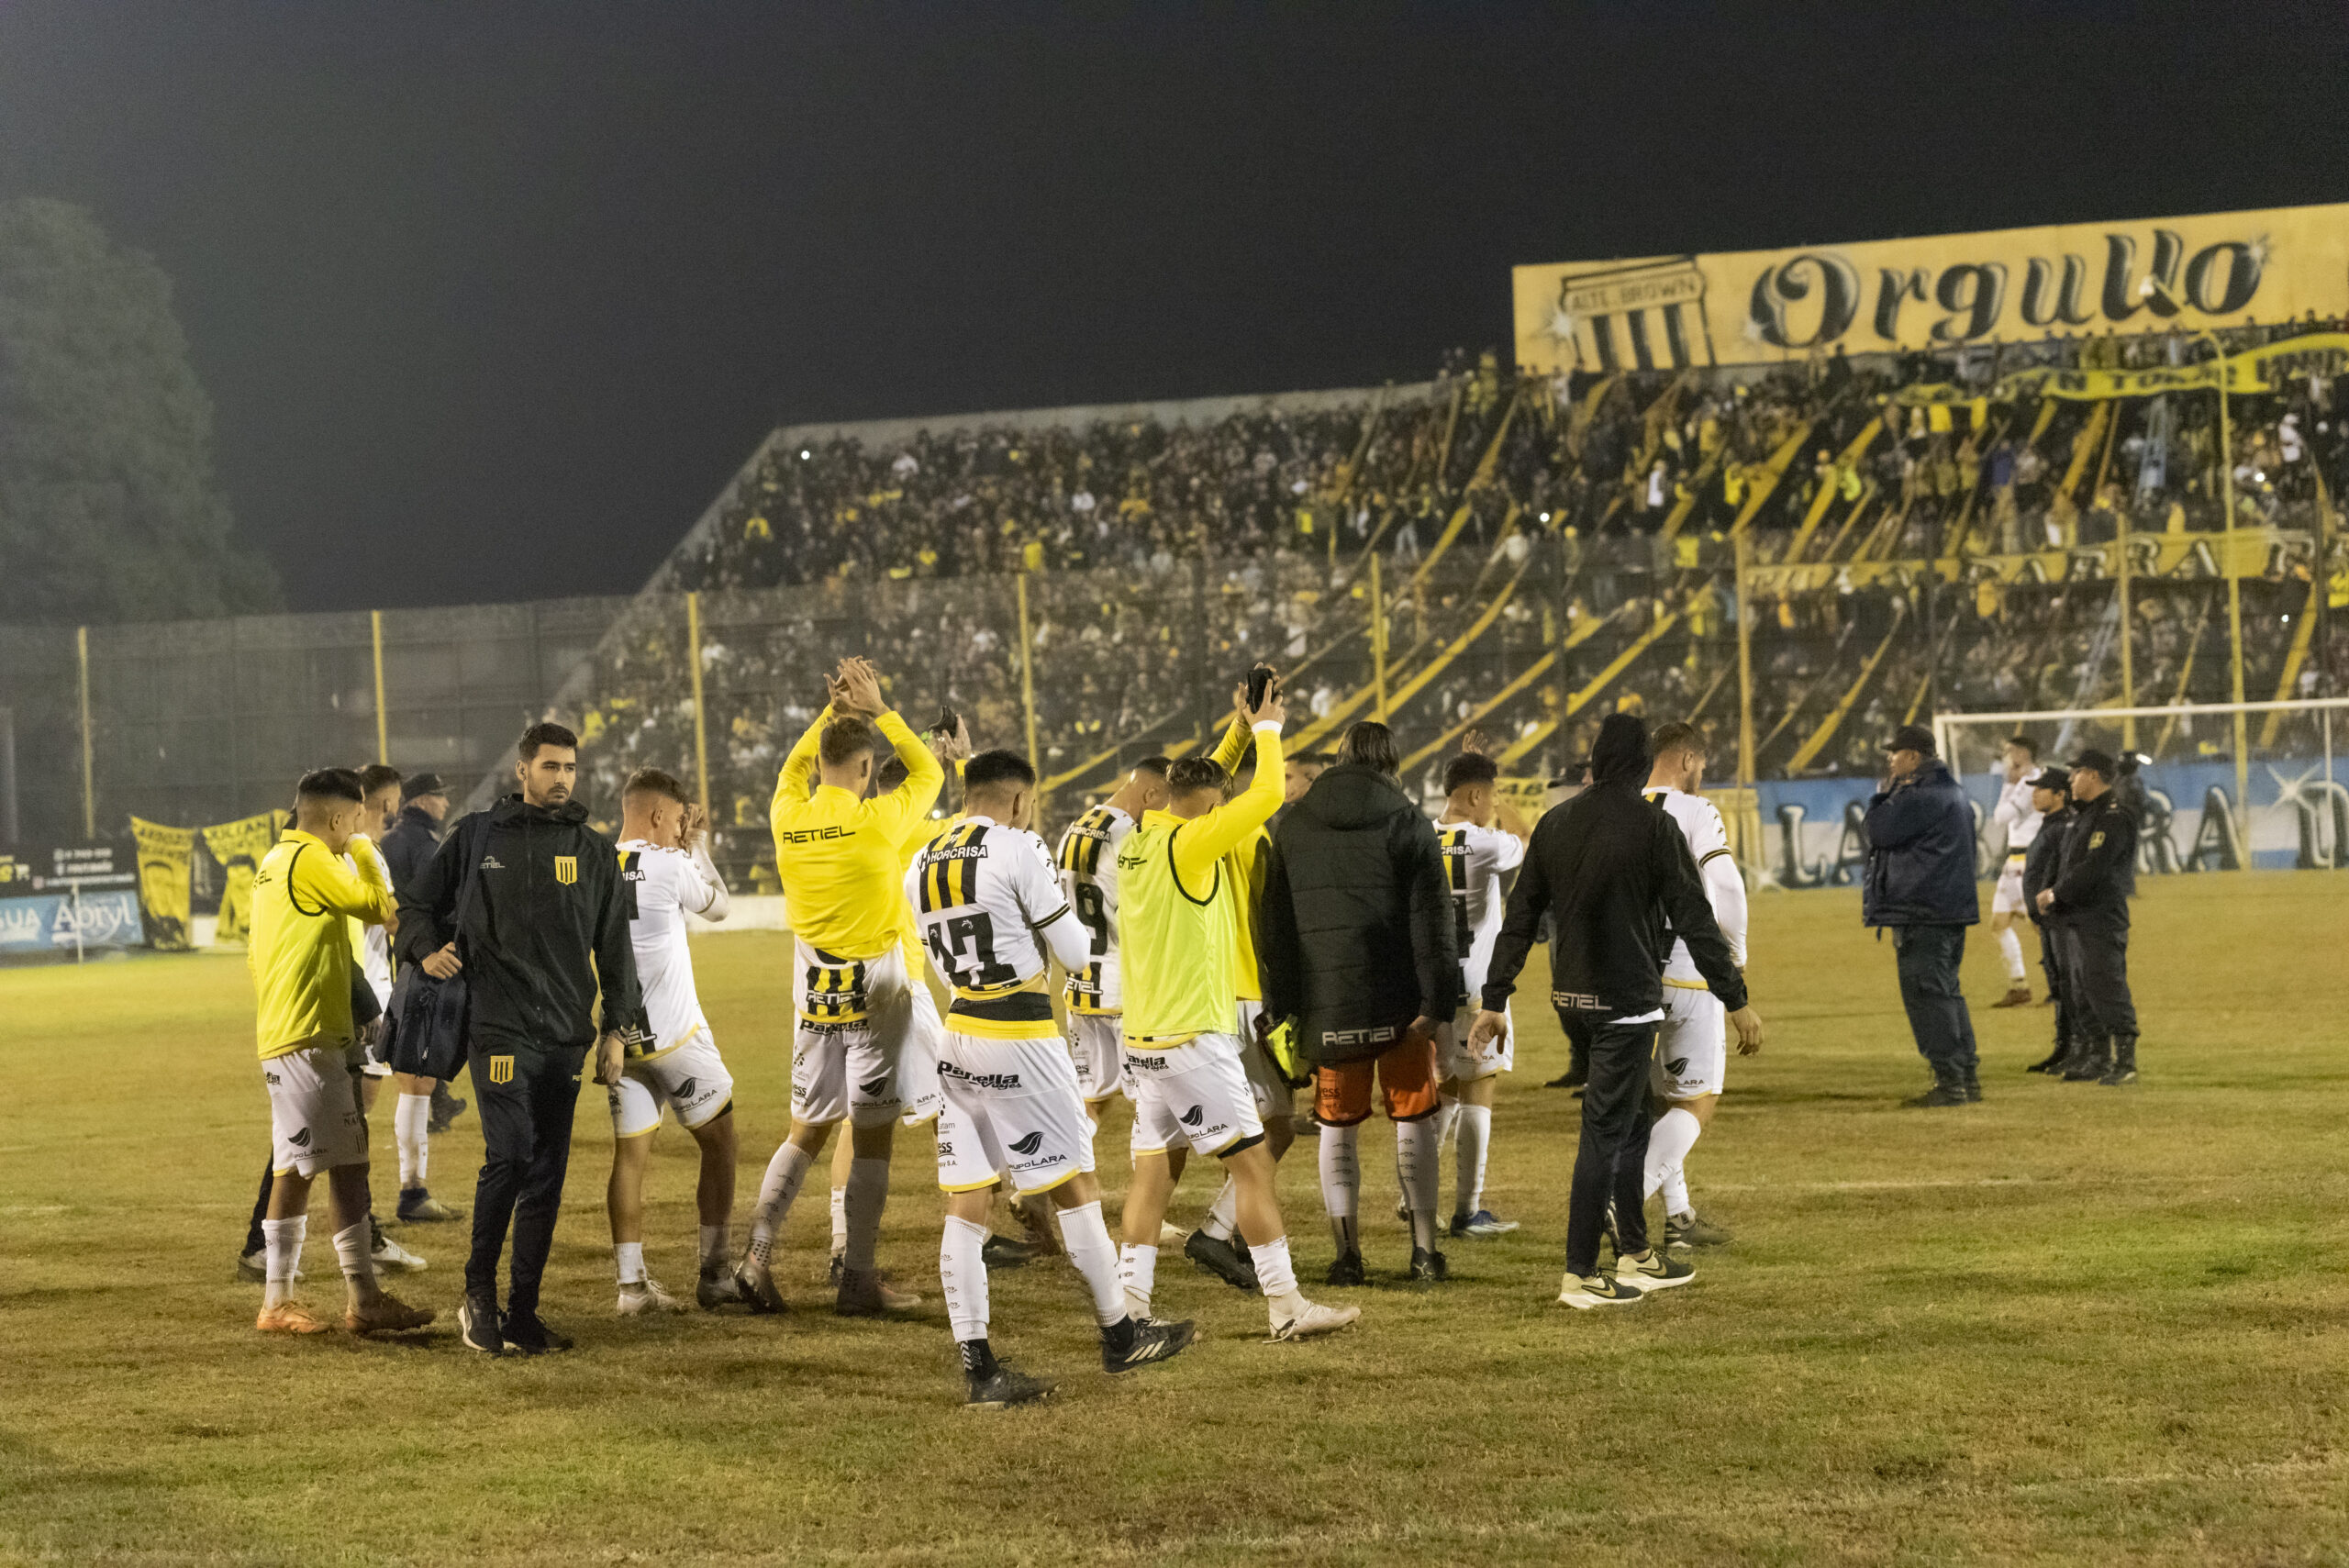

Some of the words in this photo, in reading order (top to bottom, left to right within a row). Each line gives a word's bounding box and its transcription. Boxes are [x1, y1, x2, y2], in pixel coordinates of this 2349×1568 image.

[1748, 228, 2264, 349] Orgullo
[783, 825, 856, 844] RETIEL
[930, 845, 988, 862] HORCRISA
[1441, 845, 1474, 855] CRISA
[1065, 976, 1104, 995] ETIEL
[1552, 990, 1612, 1010] RETIEL
[936, 1060, 1020, 1084] Panella
